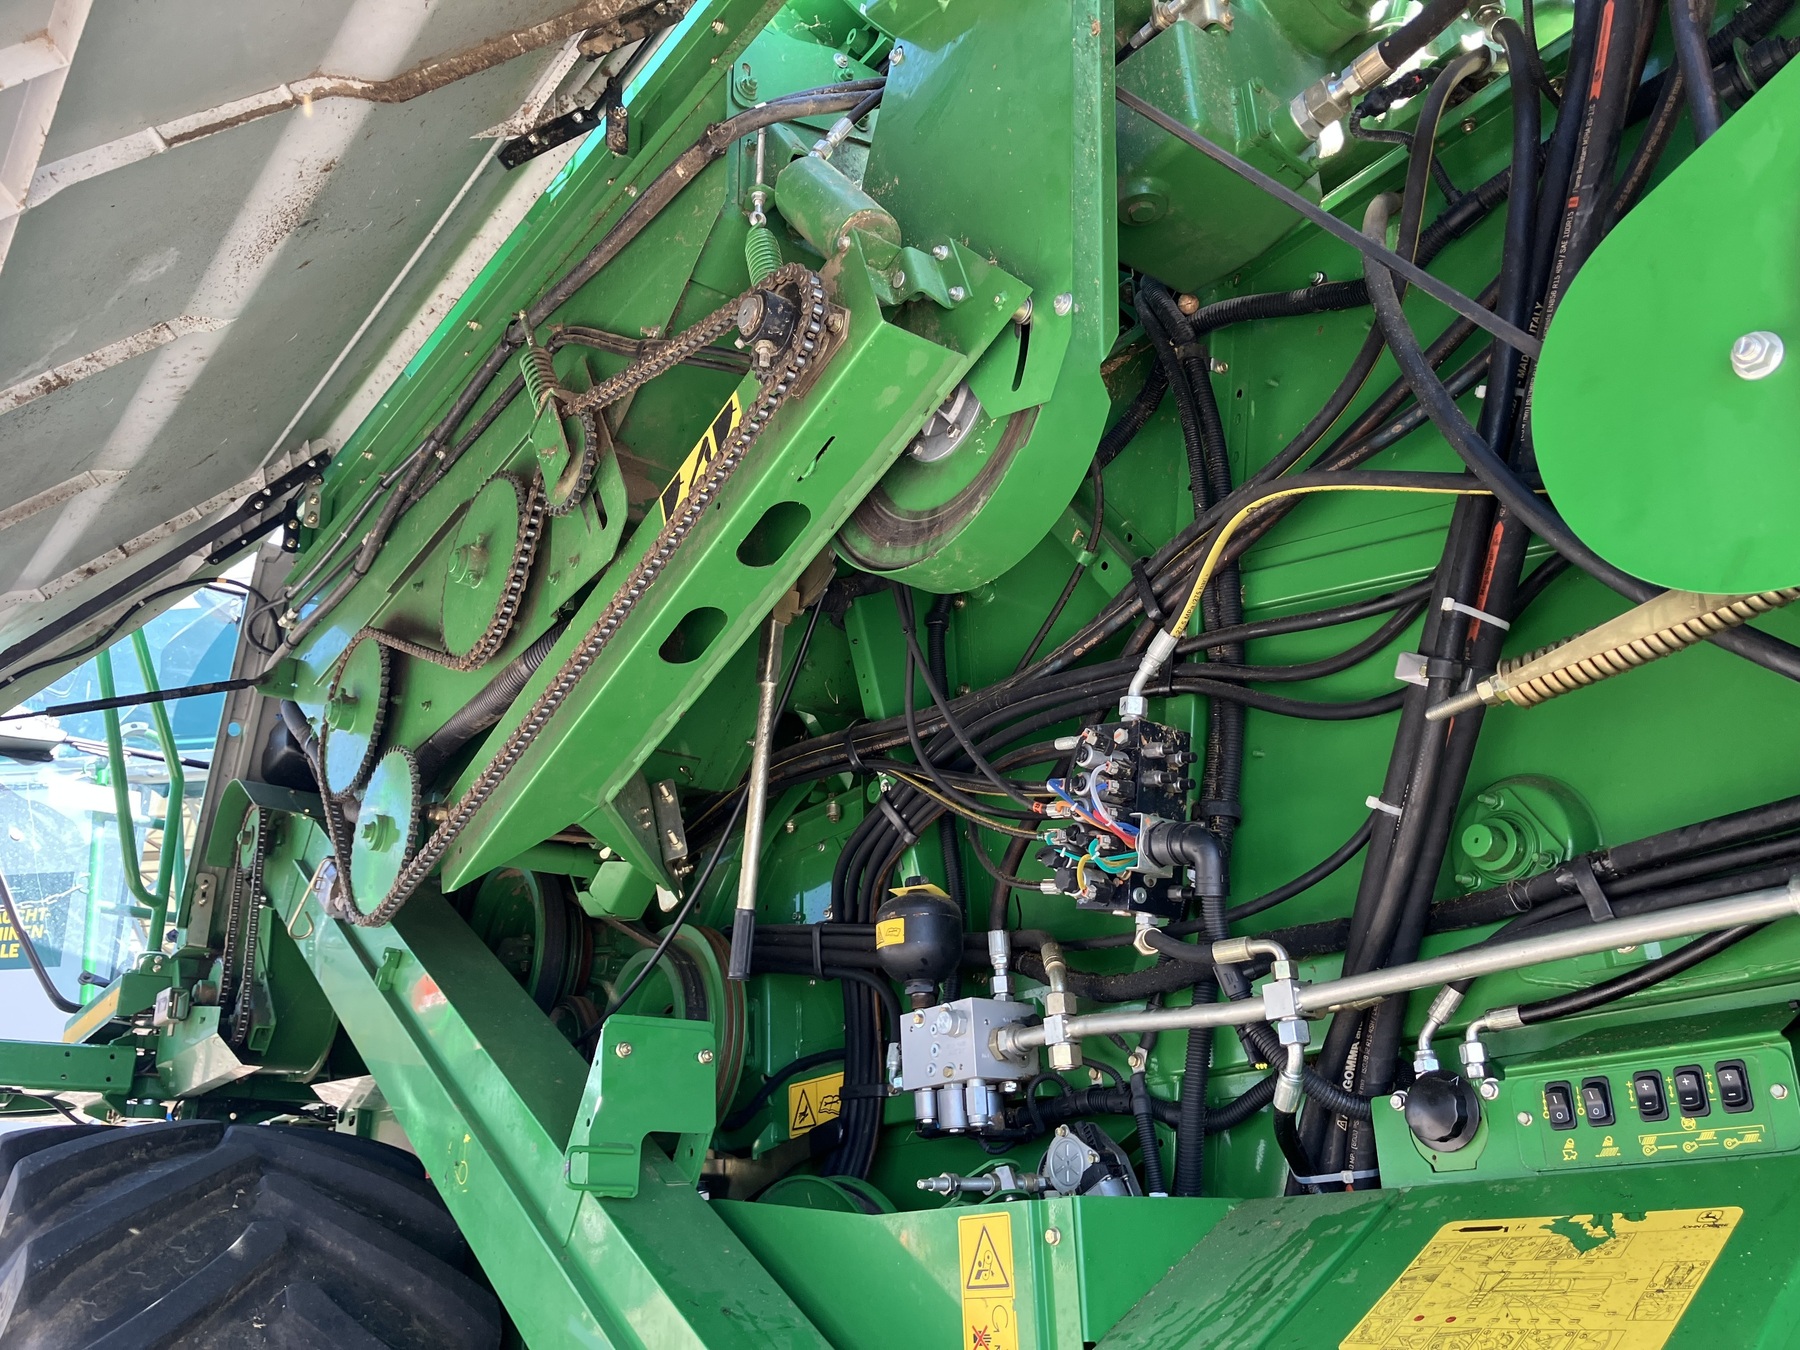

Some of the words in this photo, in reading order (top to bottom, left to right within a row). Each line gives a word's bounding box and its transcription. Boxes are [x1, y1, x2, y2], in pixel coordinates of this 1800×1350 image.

[1559, 240, 1568, 254] SAE
[1517, 354, 1530, 379] MAD
[1529, 302, 1544, 333] ITALY
[1184, 605, 1194, 620] MPa
